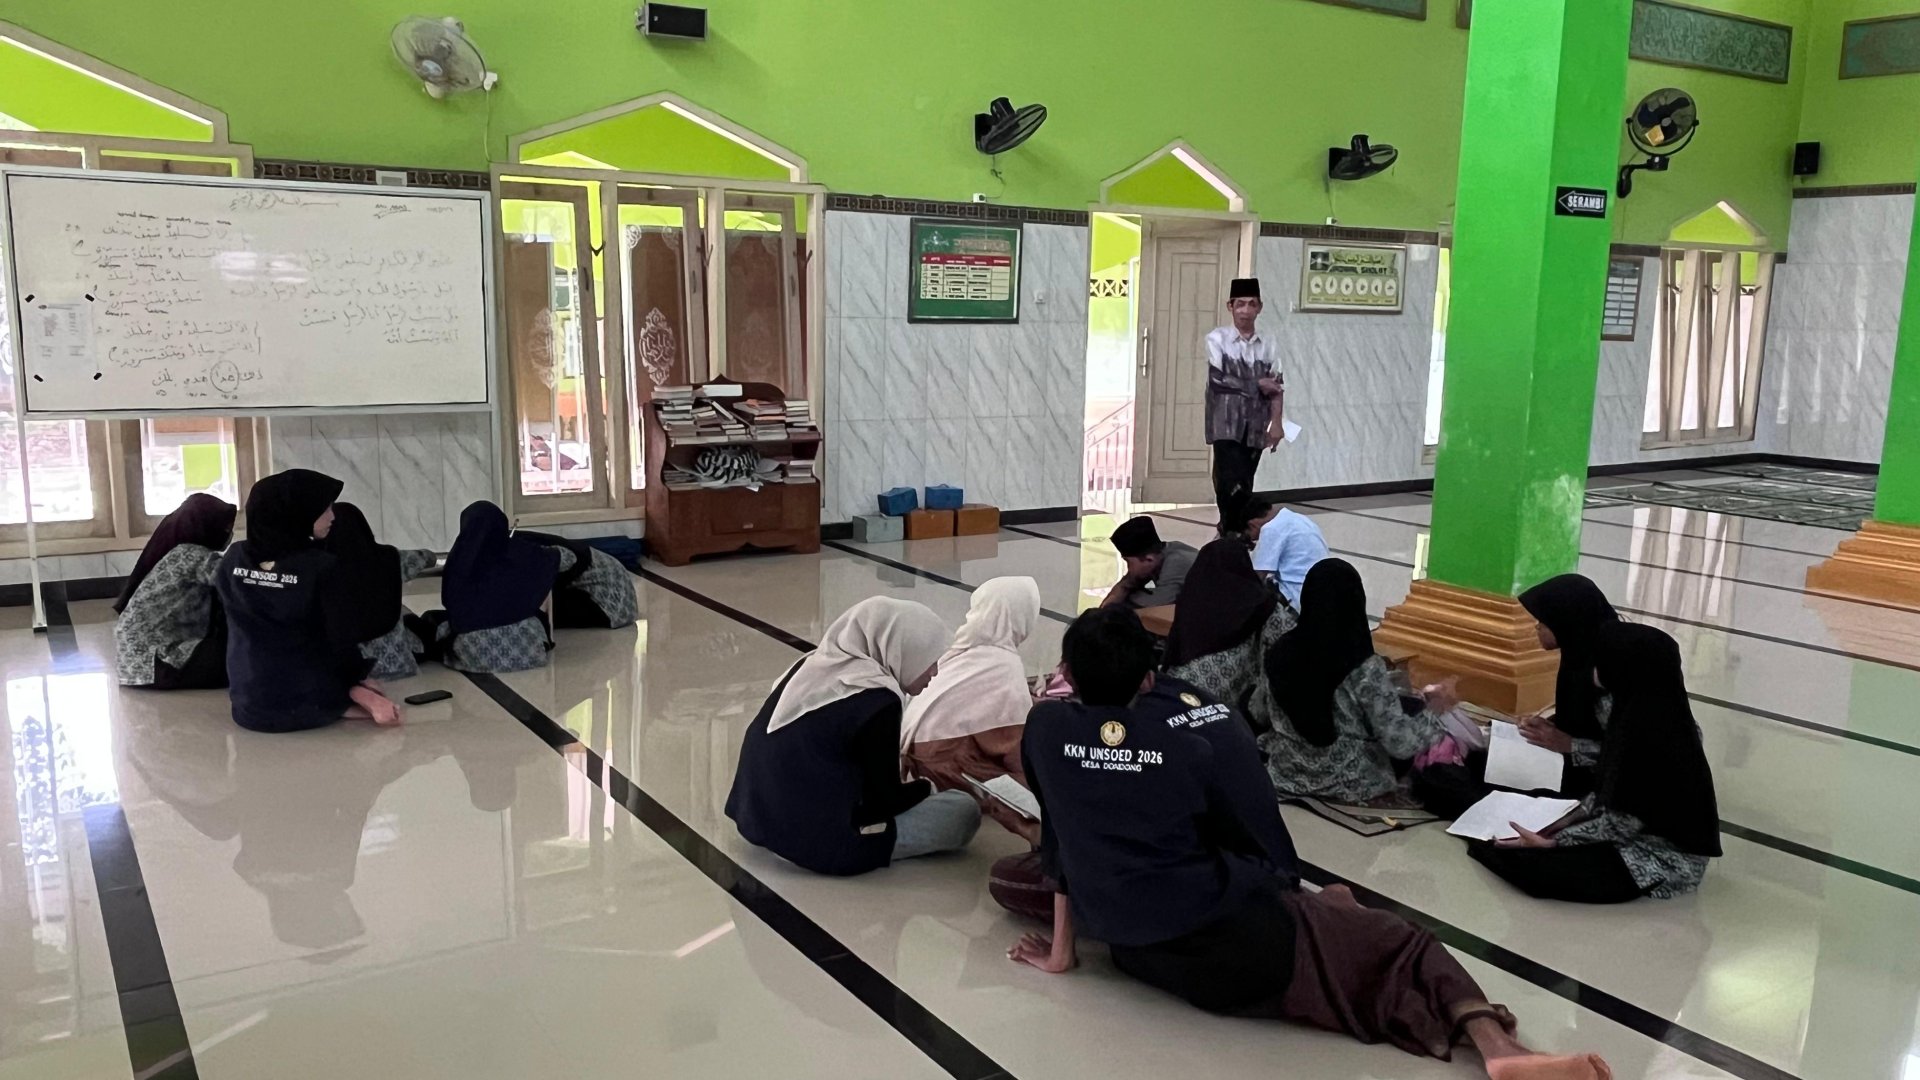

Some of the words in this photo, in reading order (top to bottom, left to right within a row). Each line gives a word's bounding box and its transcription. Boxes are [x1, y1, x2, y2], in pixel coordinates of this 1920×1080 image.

[1567, 195, 1604, 209] SERAMBI
[1166, 713, 1189, 728] KKN
[1064, 743, 1086, 758] KKN
[1089, 747, 1132, 762] UNSOED
[1138, 750, 1163, 764] 2026
[1081, 760, 1100, 769] DESA
[1103, 762, 1142, 772] DONDONG
